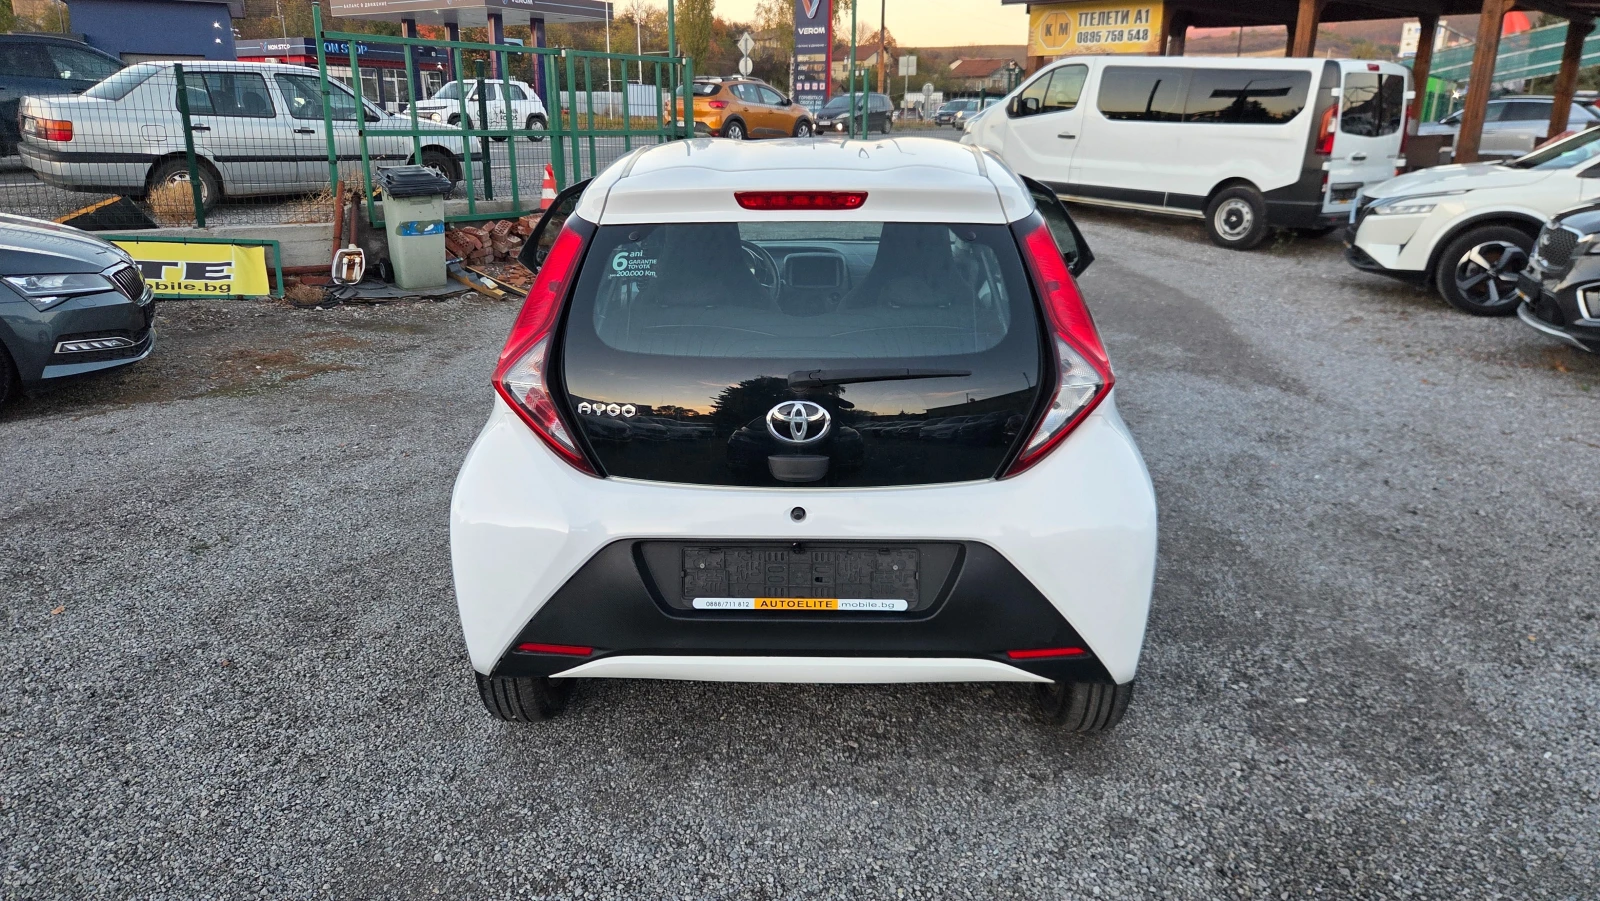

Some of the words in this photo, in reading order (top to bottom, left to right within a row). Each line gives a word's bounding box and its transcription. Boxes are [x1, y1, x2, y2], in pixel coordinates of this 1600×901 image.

[1078, 10, 1130, 27] ПЕЛЕТИ
[798, 26, 826, 35] VEROM
[1076, 31, 1101, 44] 0895
[1104, 30, 1124, 43] 759
[1127, 28, 1149, 41] 548
[612, 251, 629, 271] 6
[146, 281, 232, 293] obile.bg
[577, 401, 636, 418] AYGO
[760, 600, 833, 608] AUTOELITE
